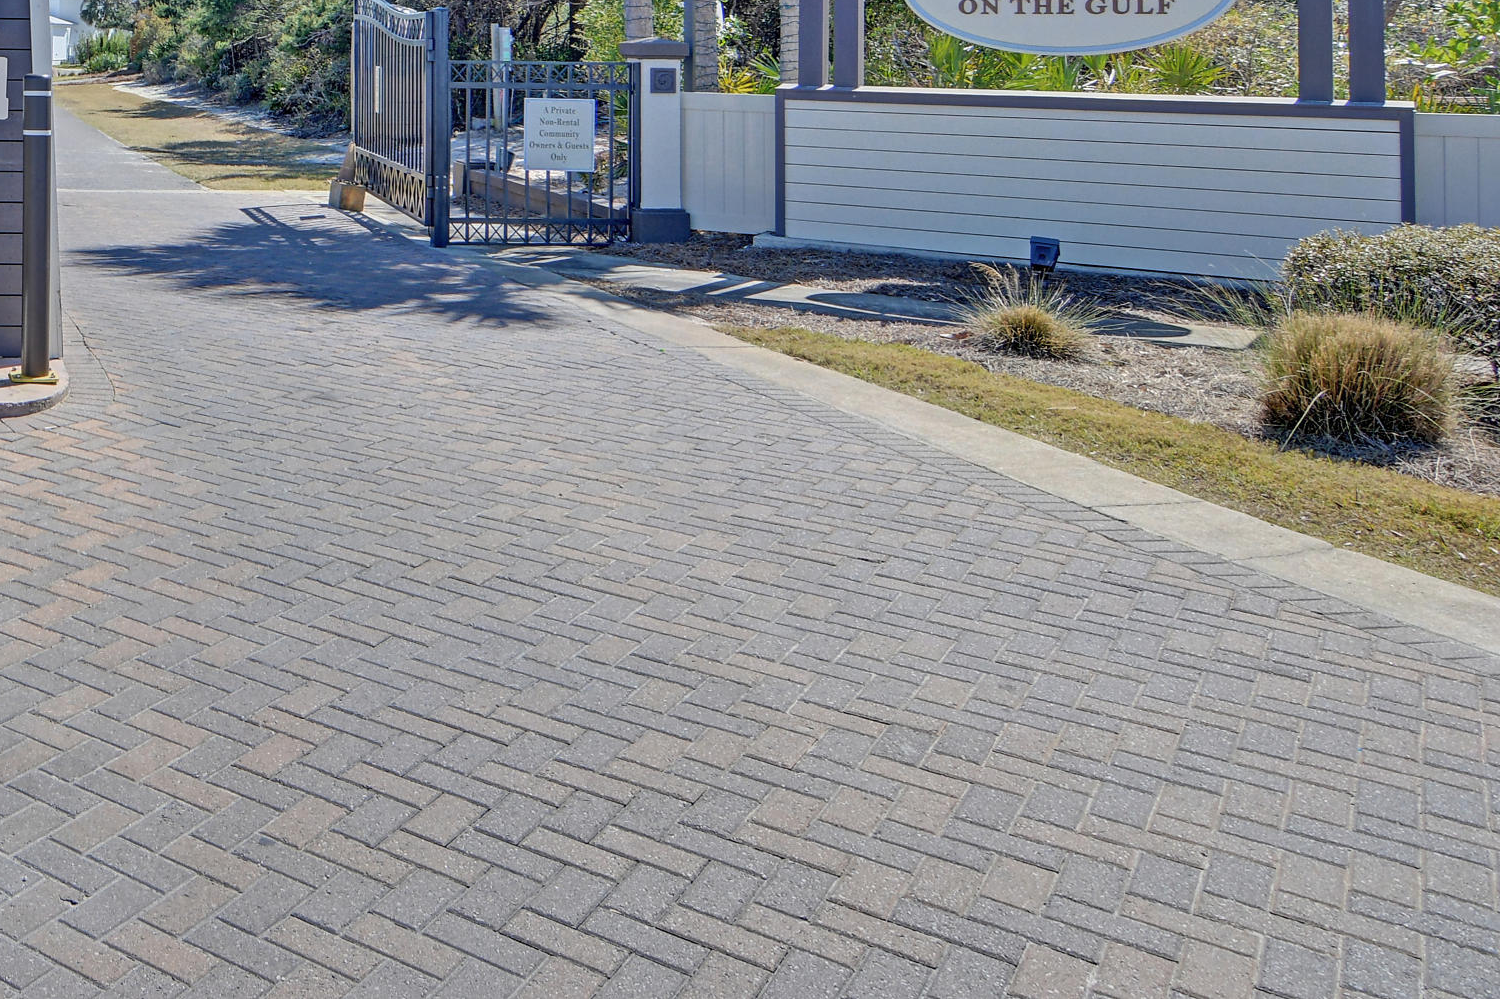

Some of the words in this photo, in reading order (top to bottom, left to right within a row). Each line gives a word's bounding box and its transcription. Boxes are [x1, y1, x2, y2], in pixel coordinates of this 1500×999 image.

[551, 106, 577, 115] Private
[540, 117, 580, 126] Non-Rental
[539, 129, 580, 140] Community
[529, 141, 556, 149] Owners
[564, 141, 590, 150] Guests
[550, 152, 568, 163] Only
